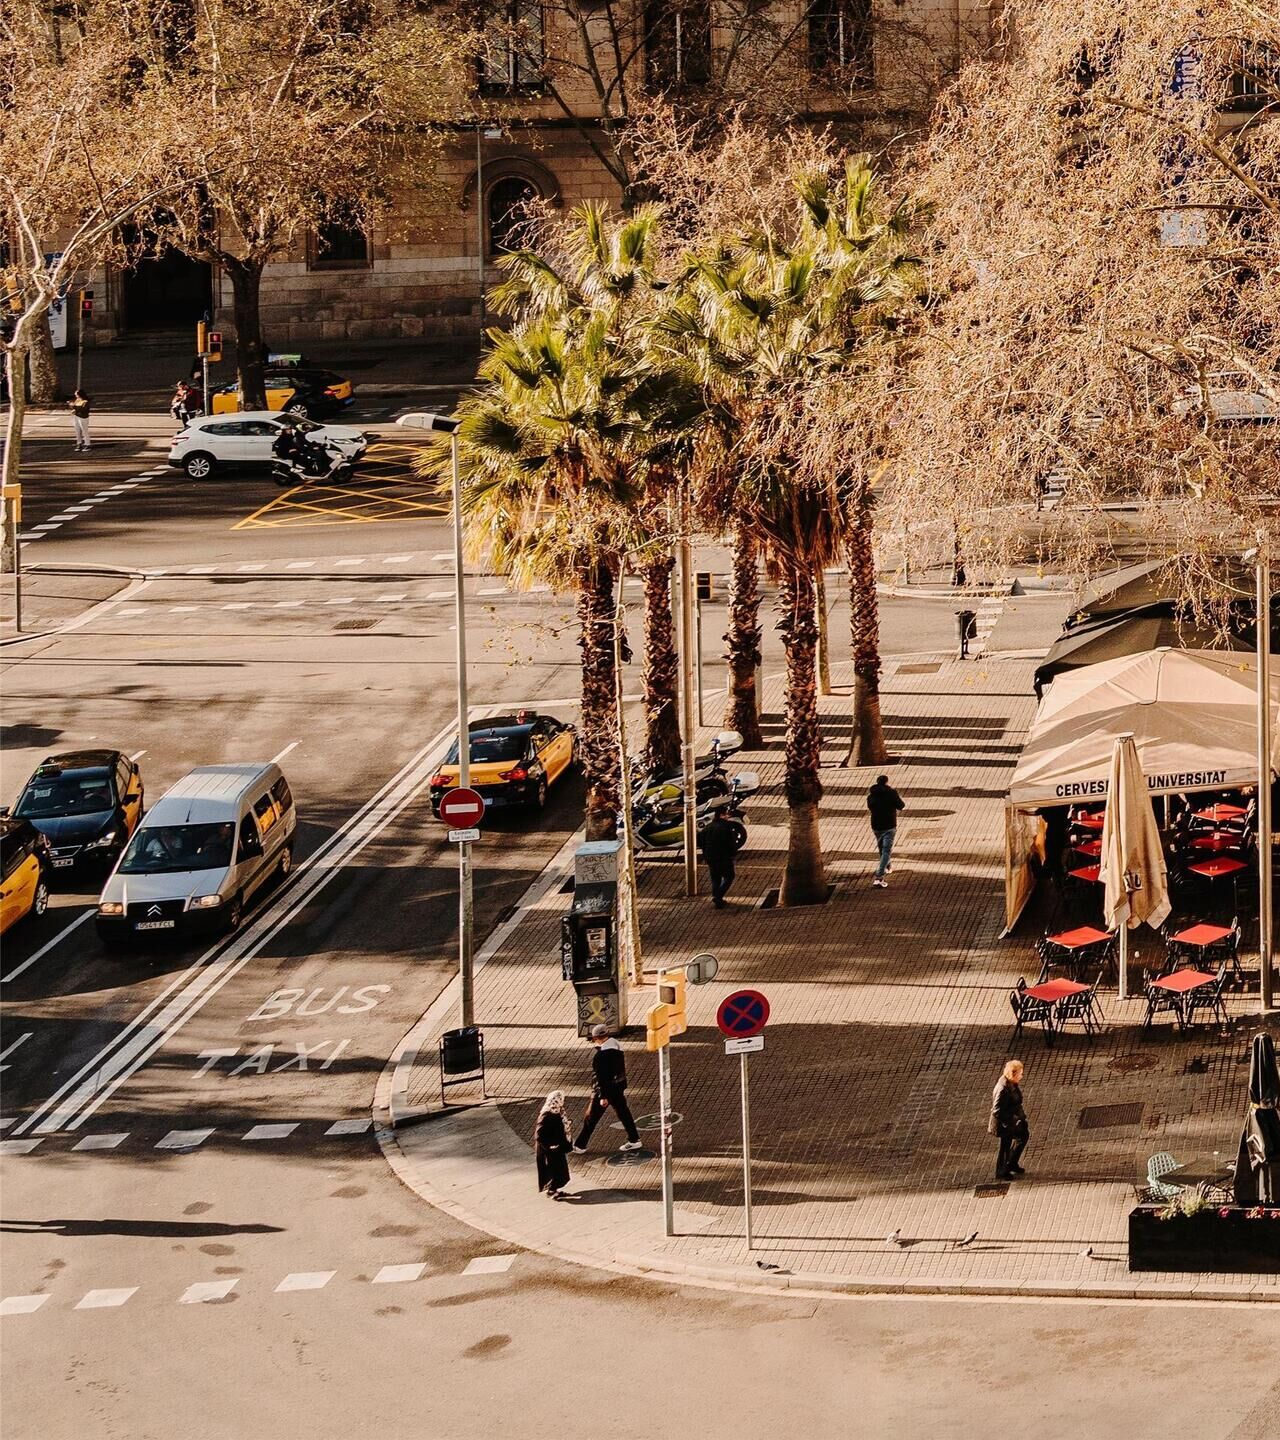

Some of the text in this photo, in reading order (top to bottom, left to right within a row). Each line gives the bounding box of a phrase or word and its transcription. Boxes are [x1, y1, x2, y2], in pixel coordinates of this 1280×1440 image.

[1149, 771, 1227, 788] UNIVERSITAT
[247, 984, 391, 1021] BUS
[192, 1039, 352, 1079] TAXI
